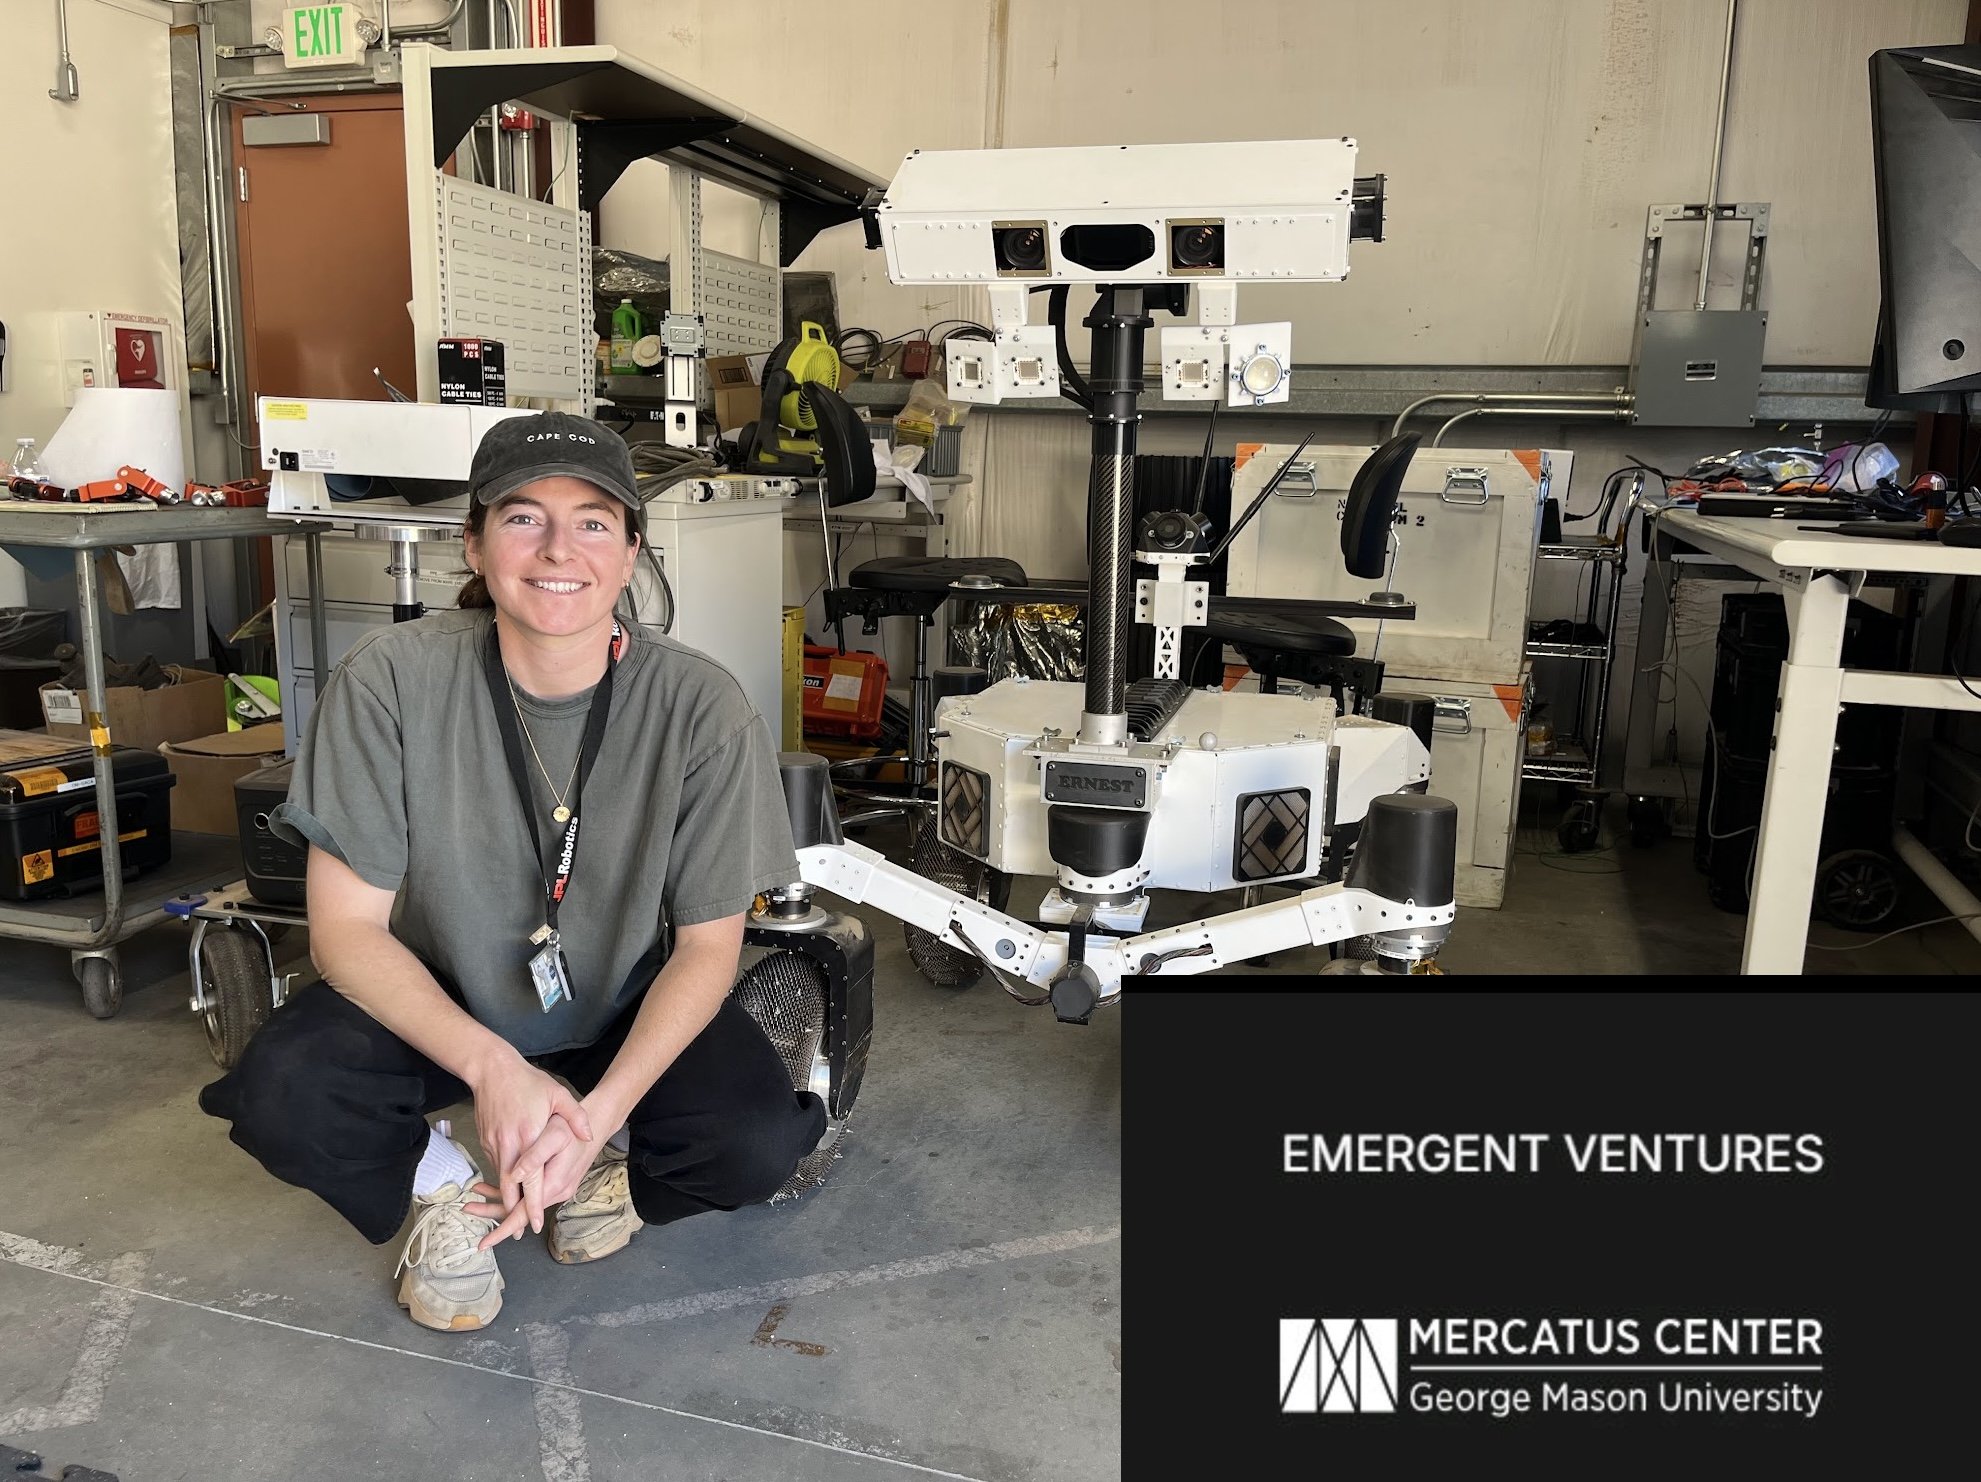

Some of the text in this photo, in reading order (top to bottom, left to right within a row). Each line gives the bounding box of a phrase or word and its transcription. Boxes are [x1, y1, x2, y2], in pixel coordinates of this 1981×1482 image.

[294, 6, 343, 58] EXIT
[526, 433, 596, 445] CAPE COD
[1416, 515, 1425, 527] 2
[1057, 775, 1135, 793] ERNEST
